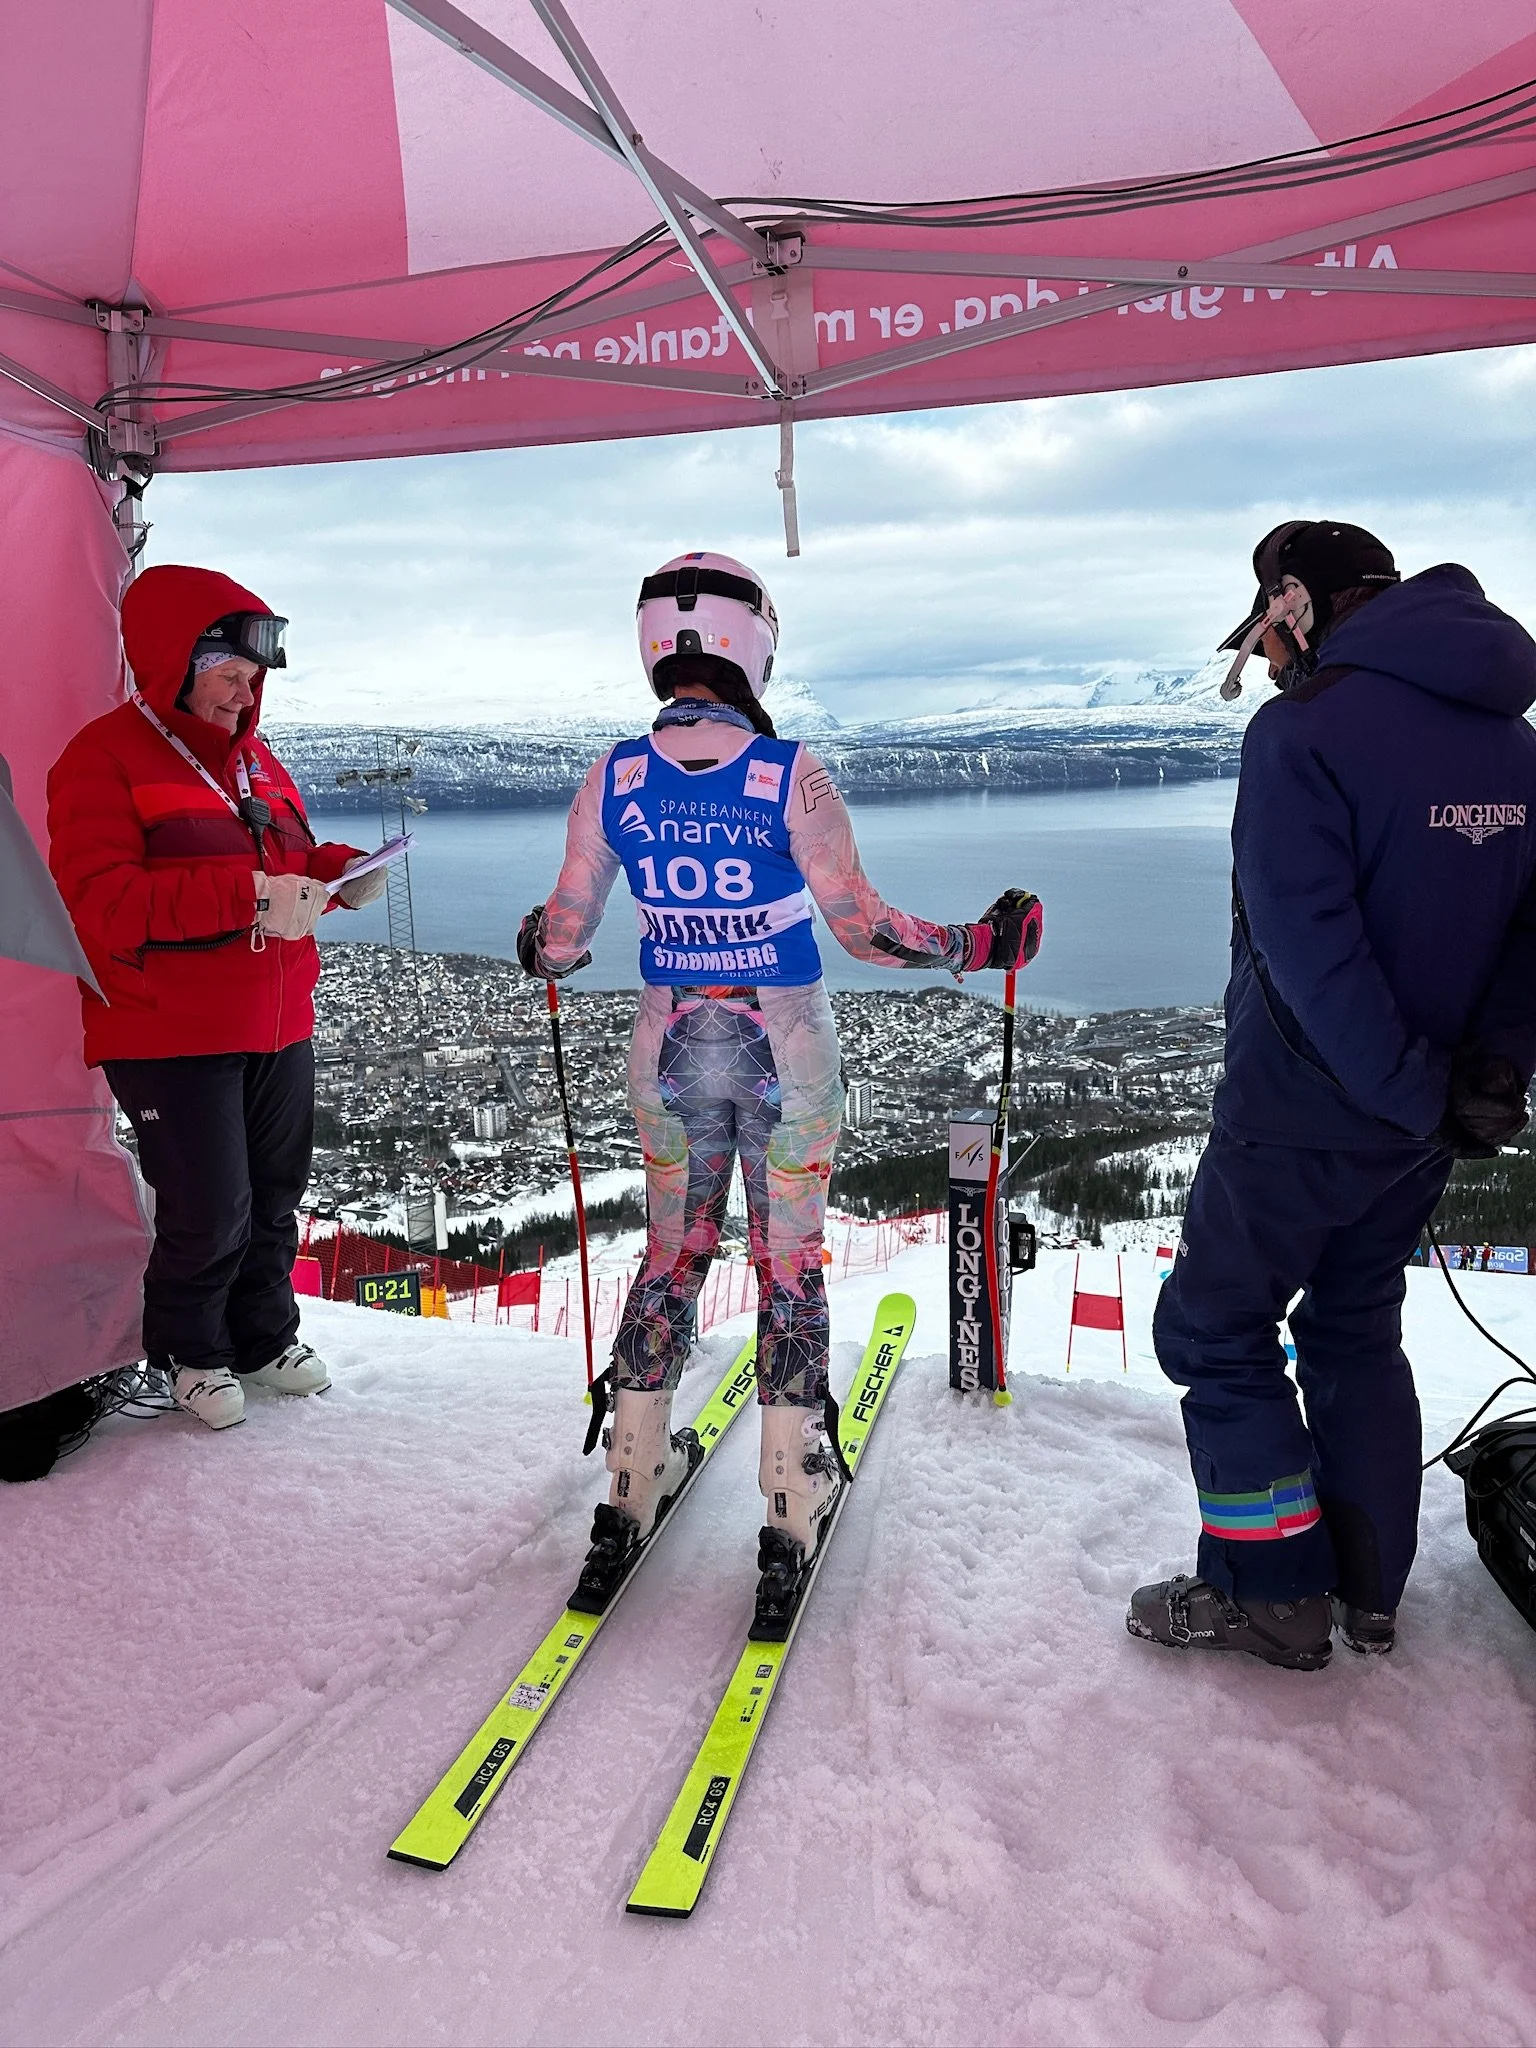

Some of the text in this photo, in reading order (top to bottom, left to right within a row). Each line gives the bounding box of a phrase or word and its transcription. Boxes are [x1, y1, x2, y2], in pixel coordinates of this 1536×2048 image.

[617, 771, 642, 785] FIS
[660, 799, 773, 827] SPAREBANKEN
[1429, 804, 1527, 828] LONGINES
[660, 819, 774, 848] narvik
[638, 855, 754, 901] 108
[653, 943, 779, 972] STRØMBERG
[140, 1108, 160, 1122] HH
[955, 1151, 984, 1162] FIS
[364, 1278, 411, 1302] 0:21
[956, 1203, 982, 1392] LONGINES
[853, 1343, 898, 1423] FISCHER
[809, 1484, 839, 1527] HEAD
[475, 1742, 510, 1785] RC4 GS
[697, 1779, 726, 1827] RC4 GS
